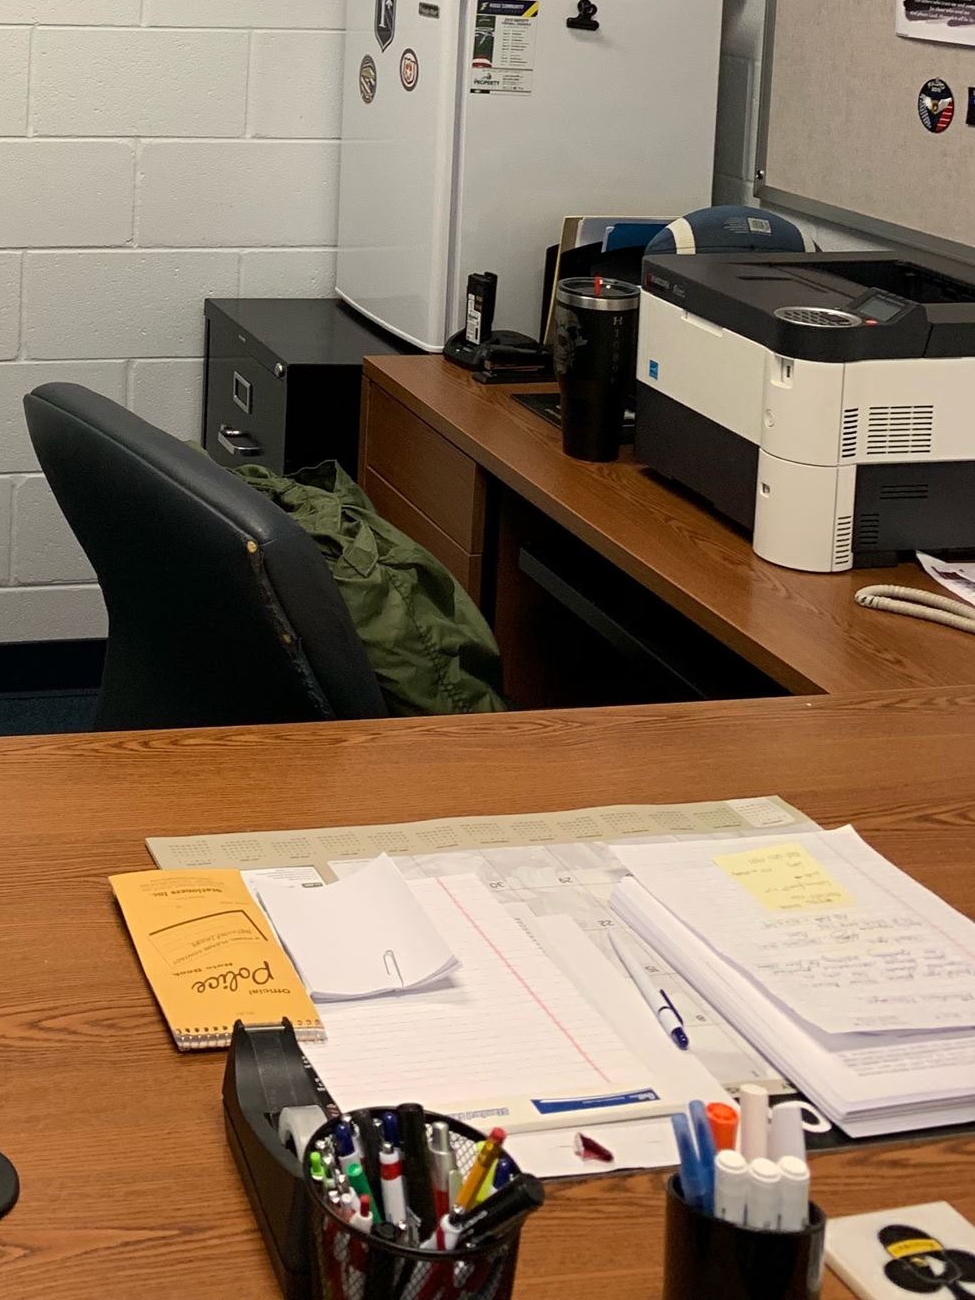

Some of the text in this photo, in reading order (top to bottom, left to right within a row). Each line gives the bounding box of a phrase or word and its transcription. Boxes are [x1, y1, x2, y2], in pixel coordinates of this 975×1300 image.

[170, 887, 222, 896] Stationers
[597, 919, 613, 928] 22
[191, 961, 274, 994] Police
[248, 987, 291, 995] Official
